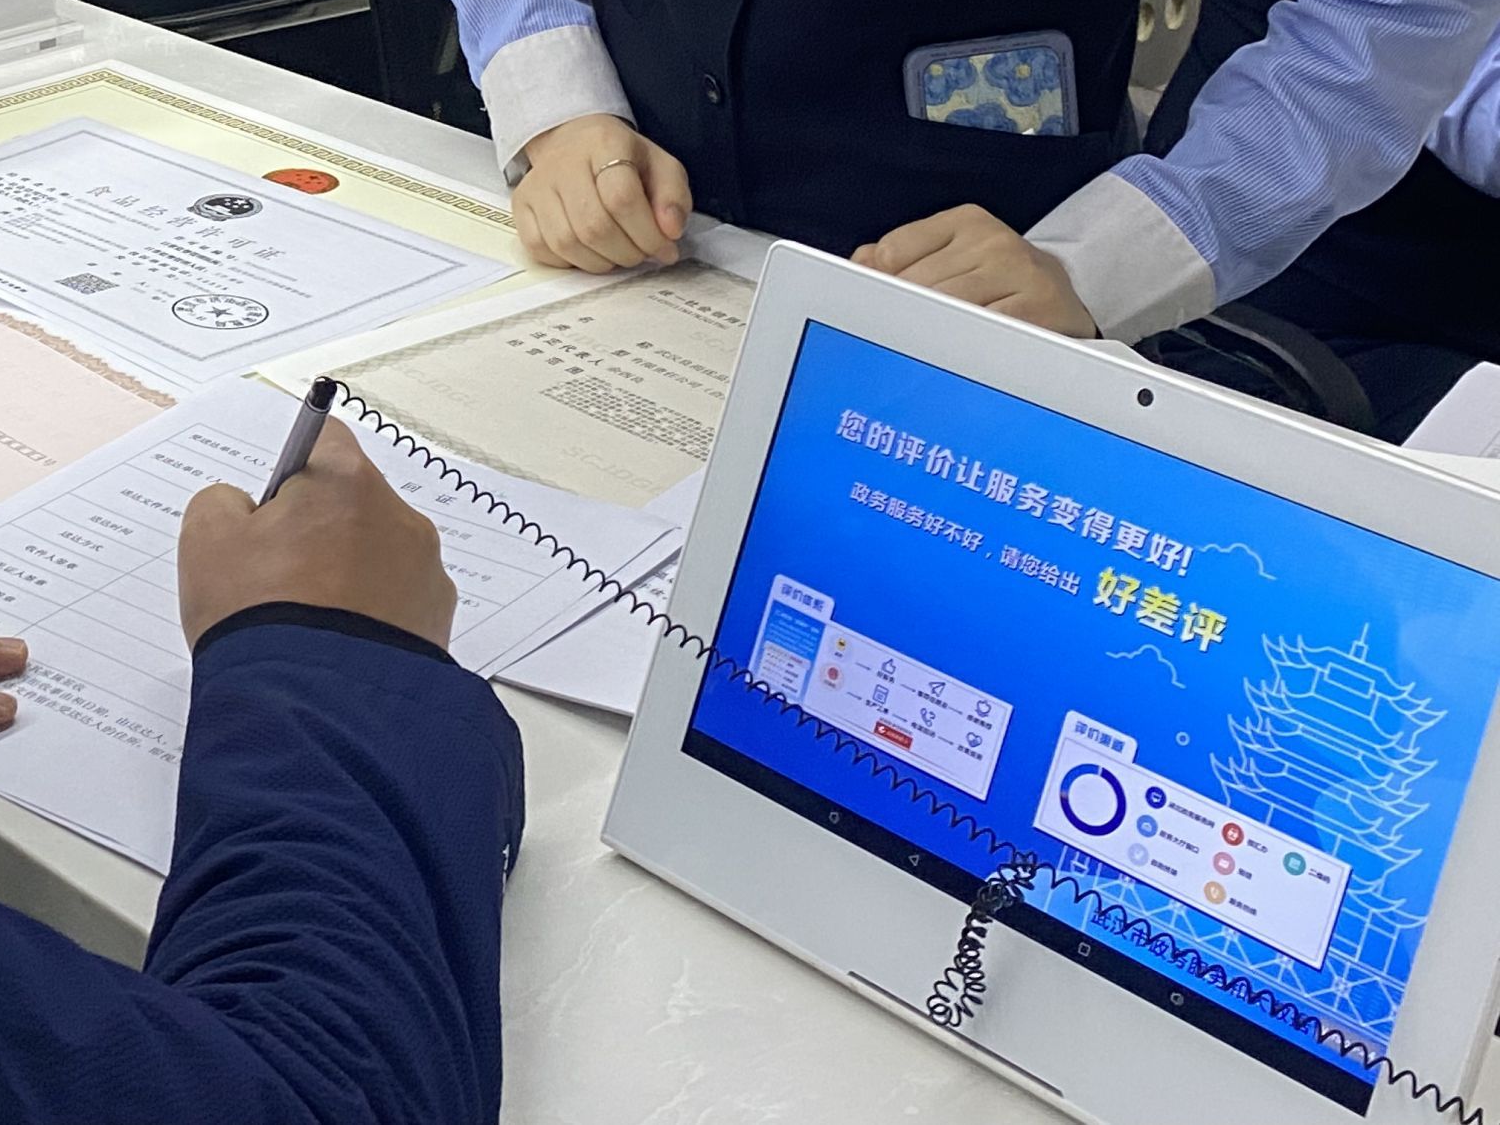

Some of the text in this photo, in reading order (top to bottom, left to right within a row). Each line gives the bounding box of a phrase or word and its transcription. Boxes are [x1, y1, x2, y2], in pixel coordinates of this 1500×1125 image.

[85, 184, 287, 261] 食品经营许可证
[529, 331, 605, 367] 法定代表人
[835, 408, 1195, 577] 您的评价让服务变得更好!
[57, 530, 105, 552] 送达方式
[1093, 565, 1228, 654] 好差评
